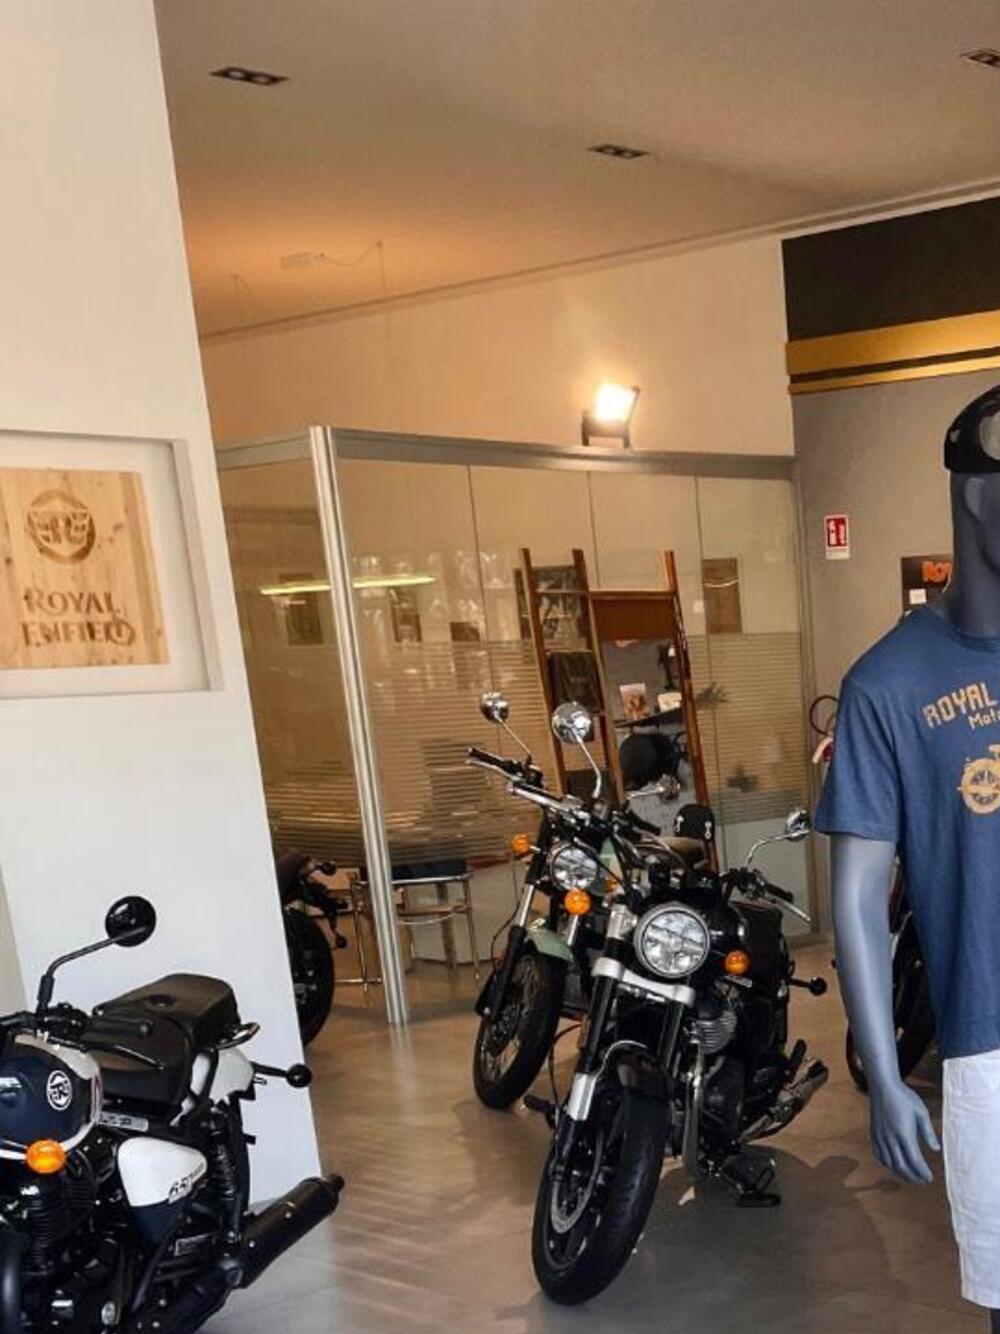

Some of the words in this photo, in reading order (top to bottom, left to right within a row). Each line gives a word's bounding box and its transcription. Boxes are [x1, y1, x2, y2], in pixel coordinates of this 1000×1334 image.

[23, 586, 121, 617] ROYAL
[21, 614, 136, 648] ENFIELD
[922, 682, 998, 729] ROYAL
